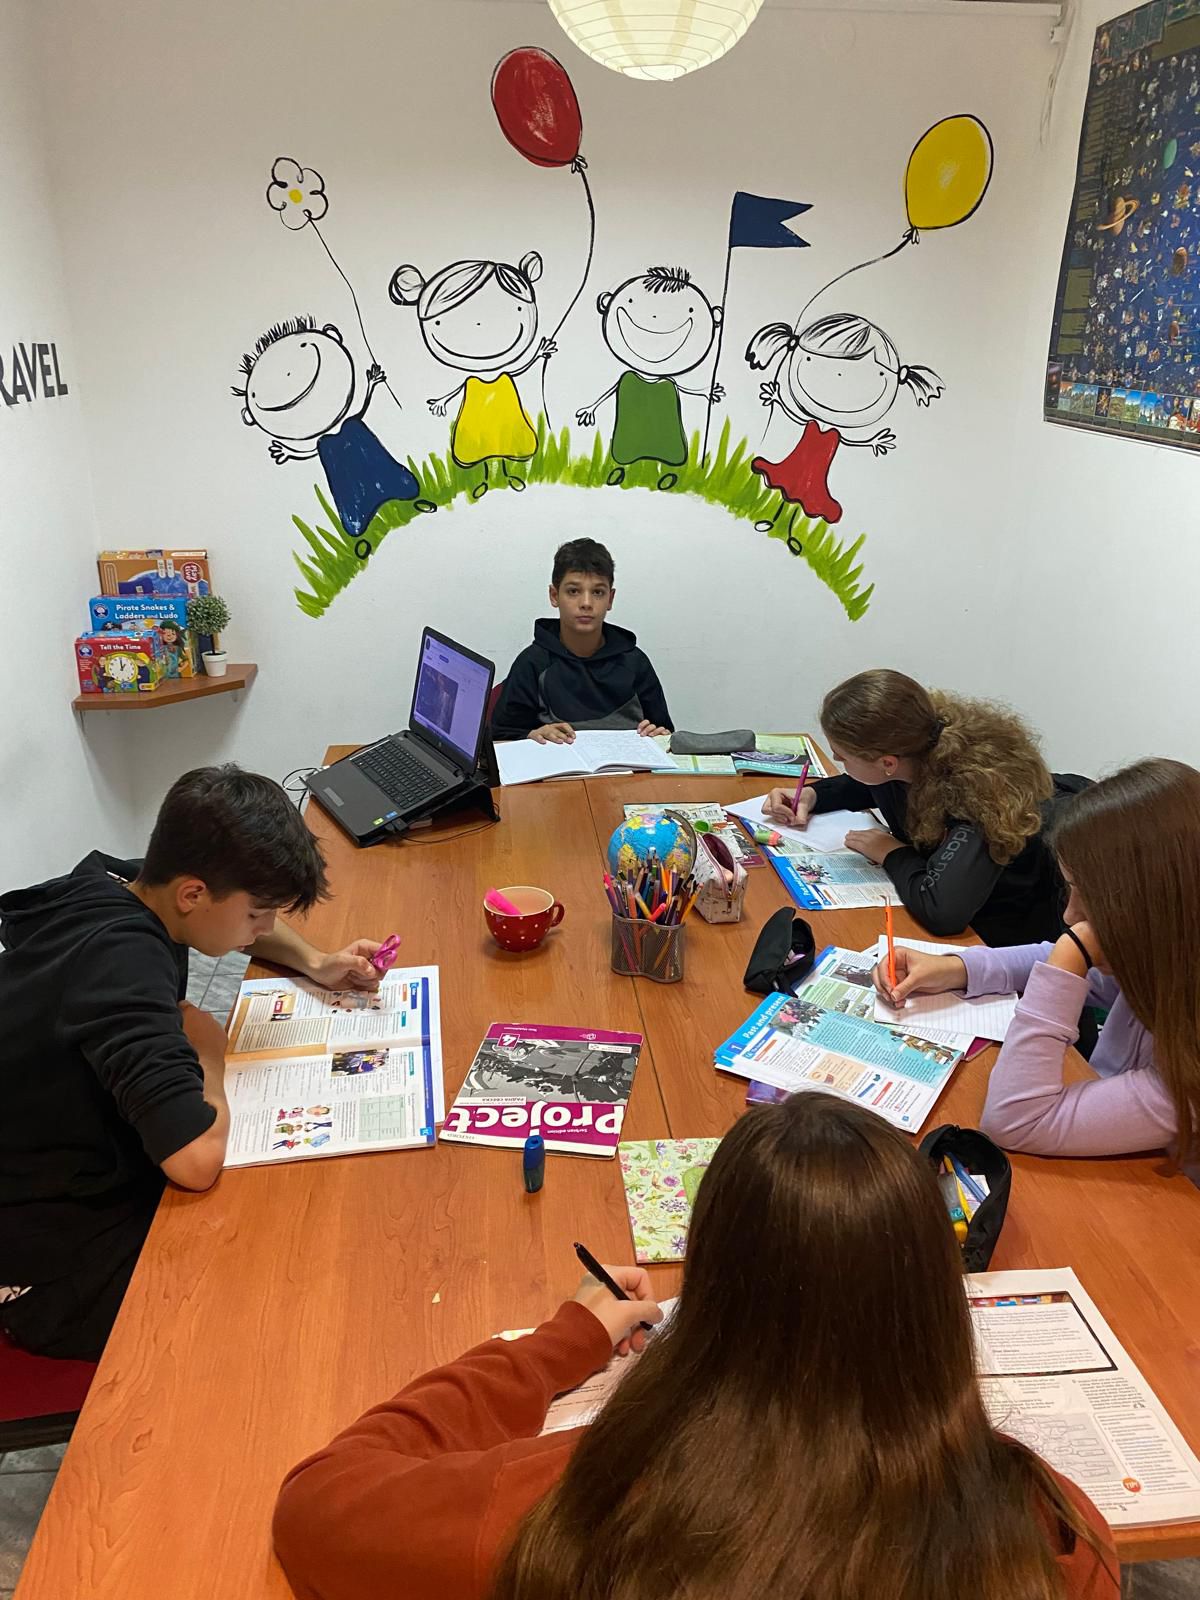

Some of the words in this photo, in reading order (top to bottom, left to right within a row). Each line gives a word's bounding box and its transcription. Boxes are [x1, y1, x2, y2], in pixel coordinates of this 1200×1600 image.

[742, 1026, 759, 1039] Past
[756, 1014, 768, 1027] and
[765, 995, 786, 1015] present
[502, 1035, 516, 1045] 4
[449, 1101, 625, 1136] Project
